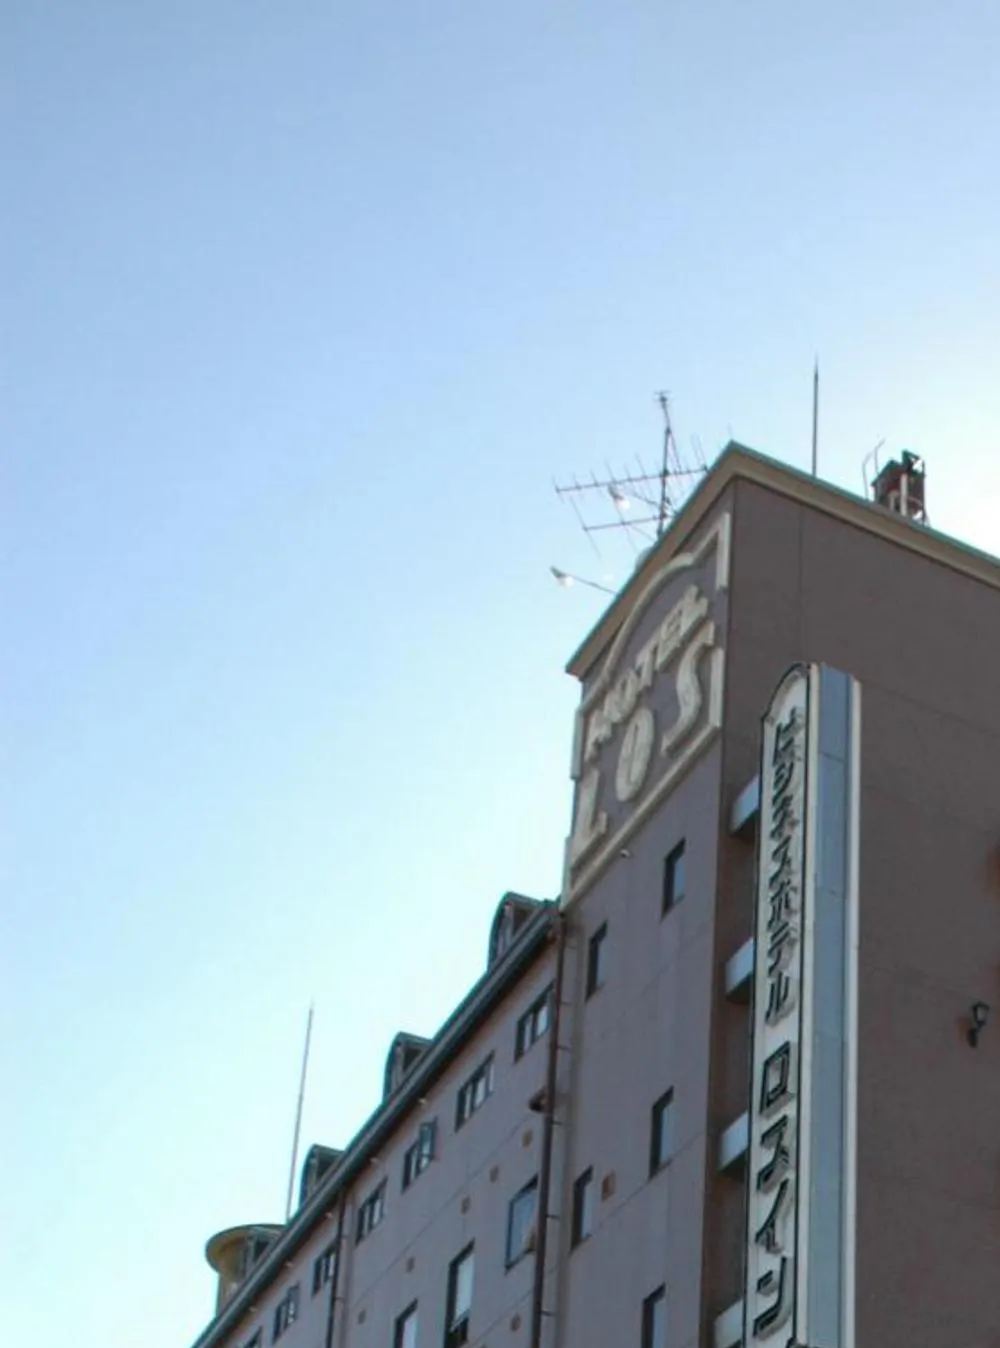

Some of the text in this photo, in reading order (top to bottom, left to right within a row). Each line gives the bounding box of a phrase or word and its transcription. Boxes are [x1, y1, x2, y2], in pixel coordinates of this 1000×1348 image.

[572, 618, 716, 868] LOS
[584, 584, 709, 763] HOTEL
[753, 705, 801, 1340] ビジネスホテル ロスイン
